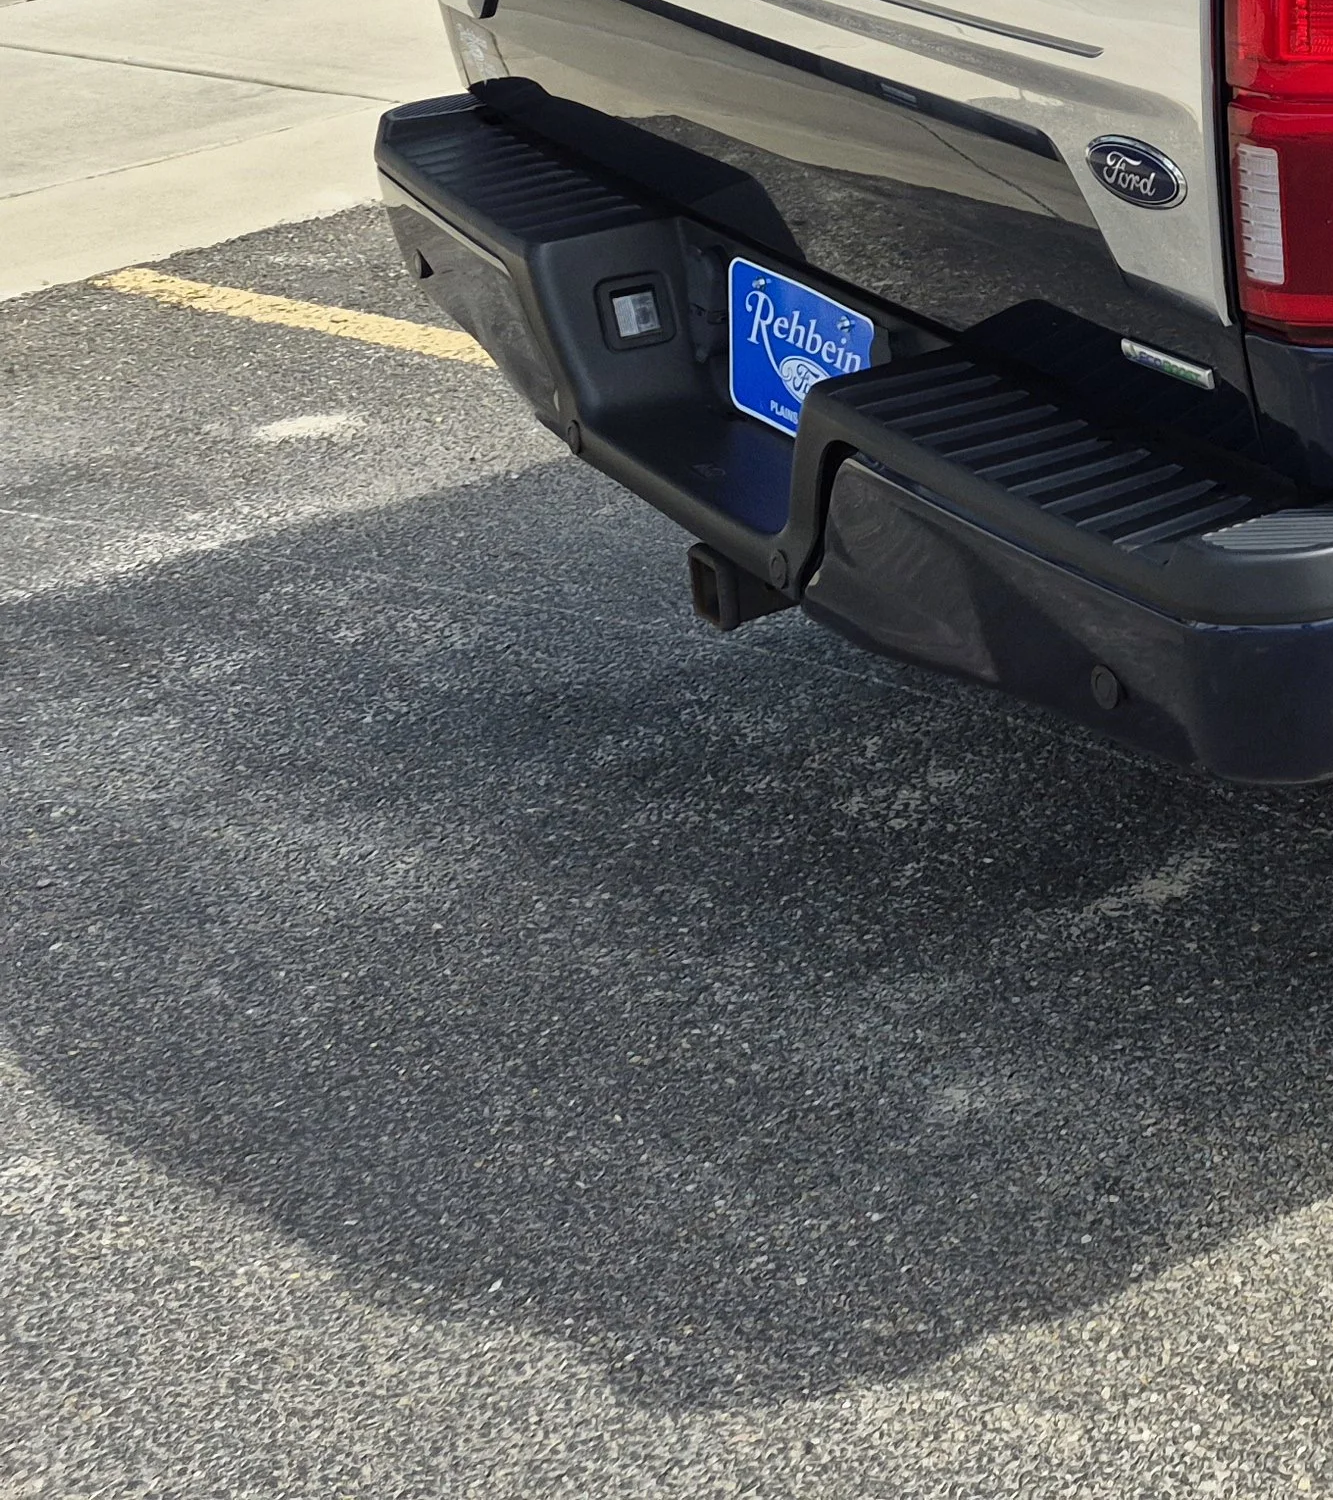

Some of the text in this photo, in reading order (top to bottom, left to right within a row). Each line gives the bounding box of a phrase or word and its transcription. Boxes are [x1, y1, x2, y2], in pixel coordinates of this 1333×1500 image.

[1103, 151, 1156, 197] Ford
[745, 290, 862, 374] Rehbein
[770, 399, 799, 425] PLAINS
